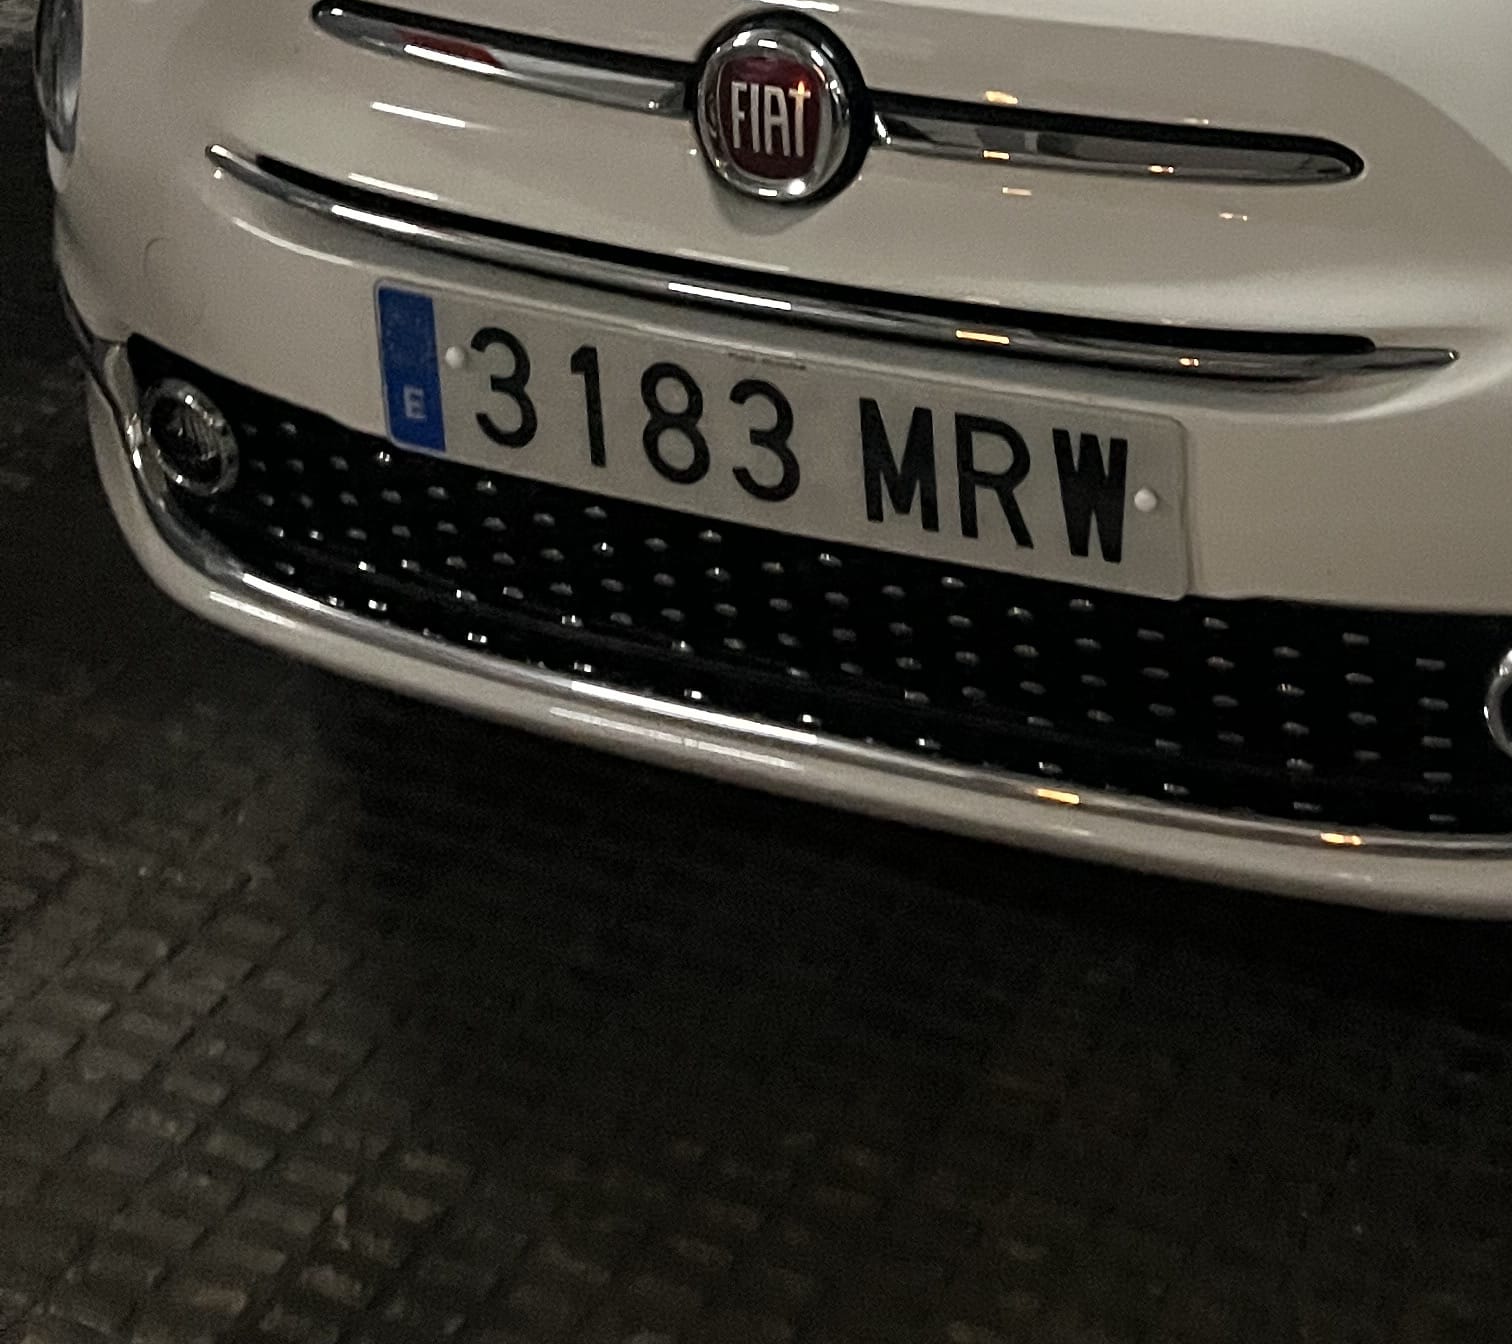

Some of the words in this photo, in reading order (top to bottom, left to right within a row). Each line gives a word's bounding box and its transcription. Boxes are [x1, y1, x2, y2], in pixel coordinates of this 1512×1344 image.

[730, 80, 811, 158] FIAT
[402, 384, 427, 419] E
[470, 326, 801, 503] 3183
[858, 396, 1129, 564] MRW
